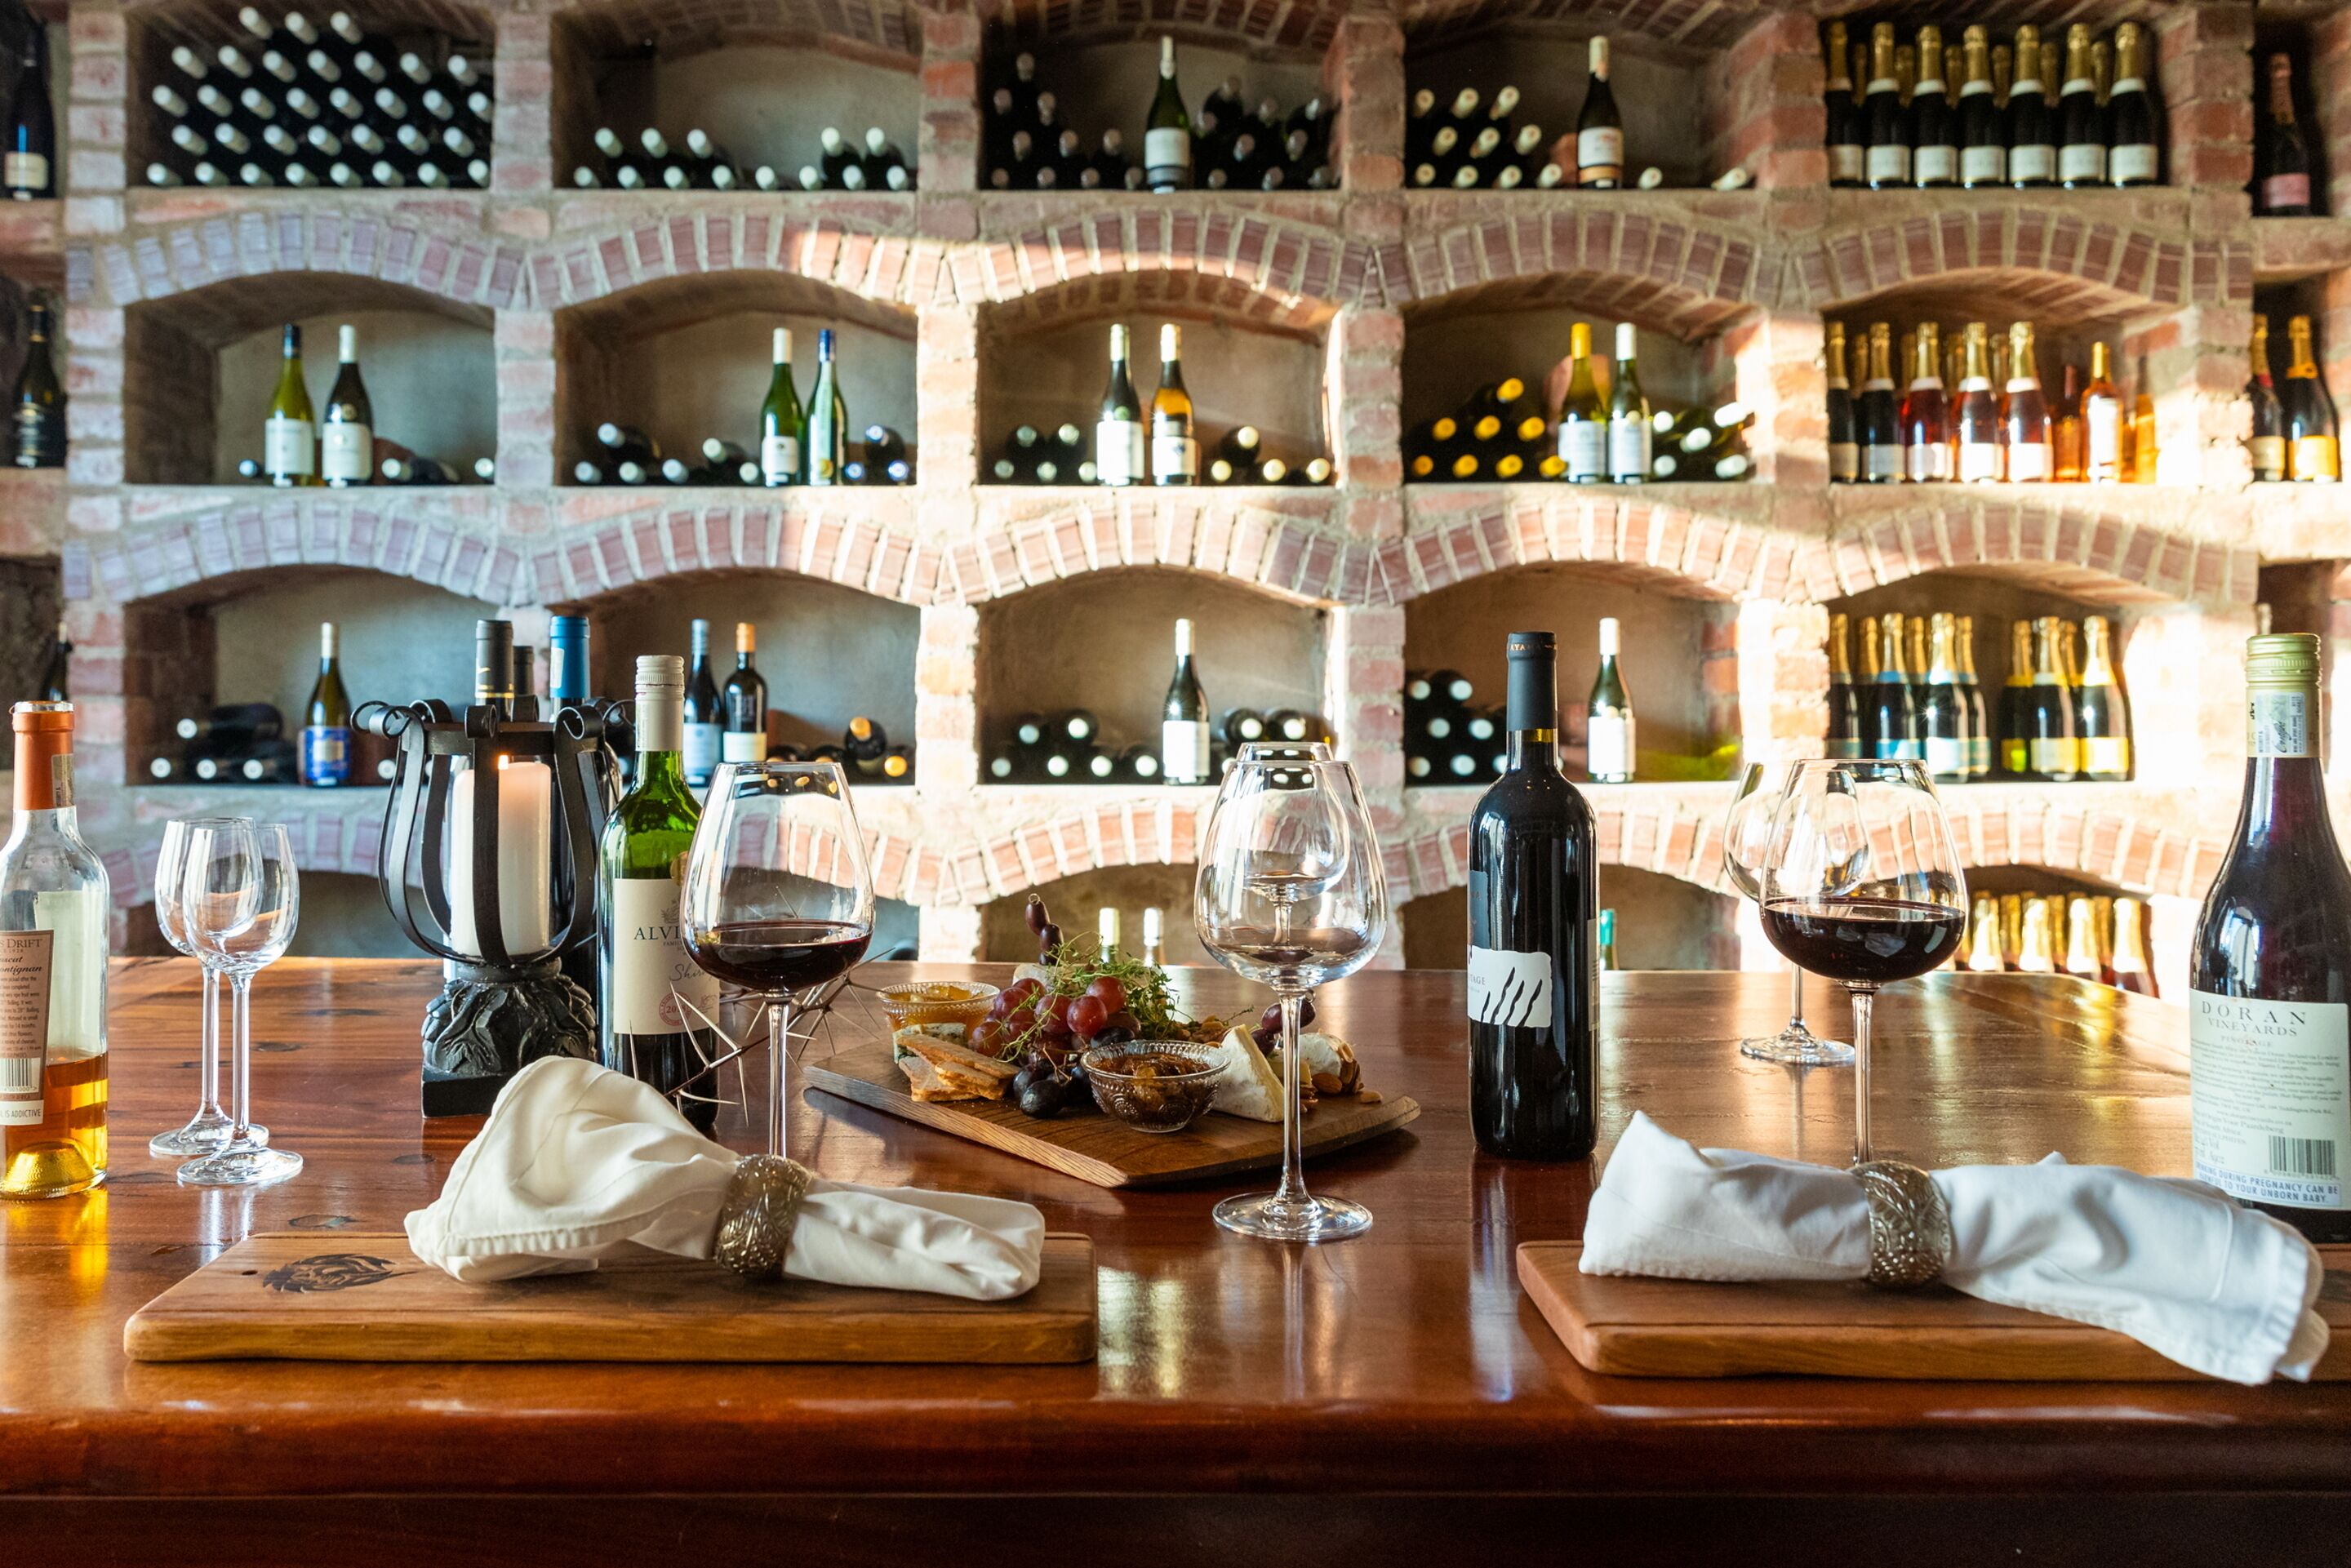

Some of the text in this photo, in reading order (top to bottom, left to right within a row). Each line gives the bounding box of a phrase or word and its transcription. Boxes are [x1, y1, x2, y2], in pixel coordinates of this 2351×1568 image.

[633, 926, 681, 940] ALVI
[7, 938, 42, 948] DRIFT
[0, 965, 42, 975] ontignan
[2202, 1001, 2305, 1025] DORAN
[2207, 1017, 2298, 1037] VINEYARDS
[11, 1108, 42, 1118] ADDICTIVE
[2218, 1169, 2247, 1184] DURING
[2250, 1177, 2303, 1192] PREGNANCY
[2306, 1184, 2325, 1194] CAN
[2327, 1185, 2339, 1195] BE
[2224, 1179, 2233, 1190] TO
[2236, 1184, 2258, 1195] YOUR
[2261, 1188, 2300, 1202] UNBORN
